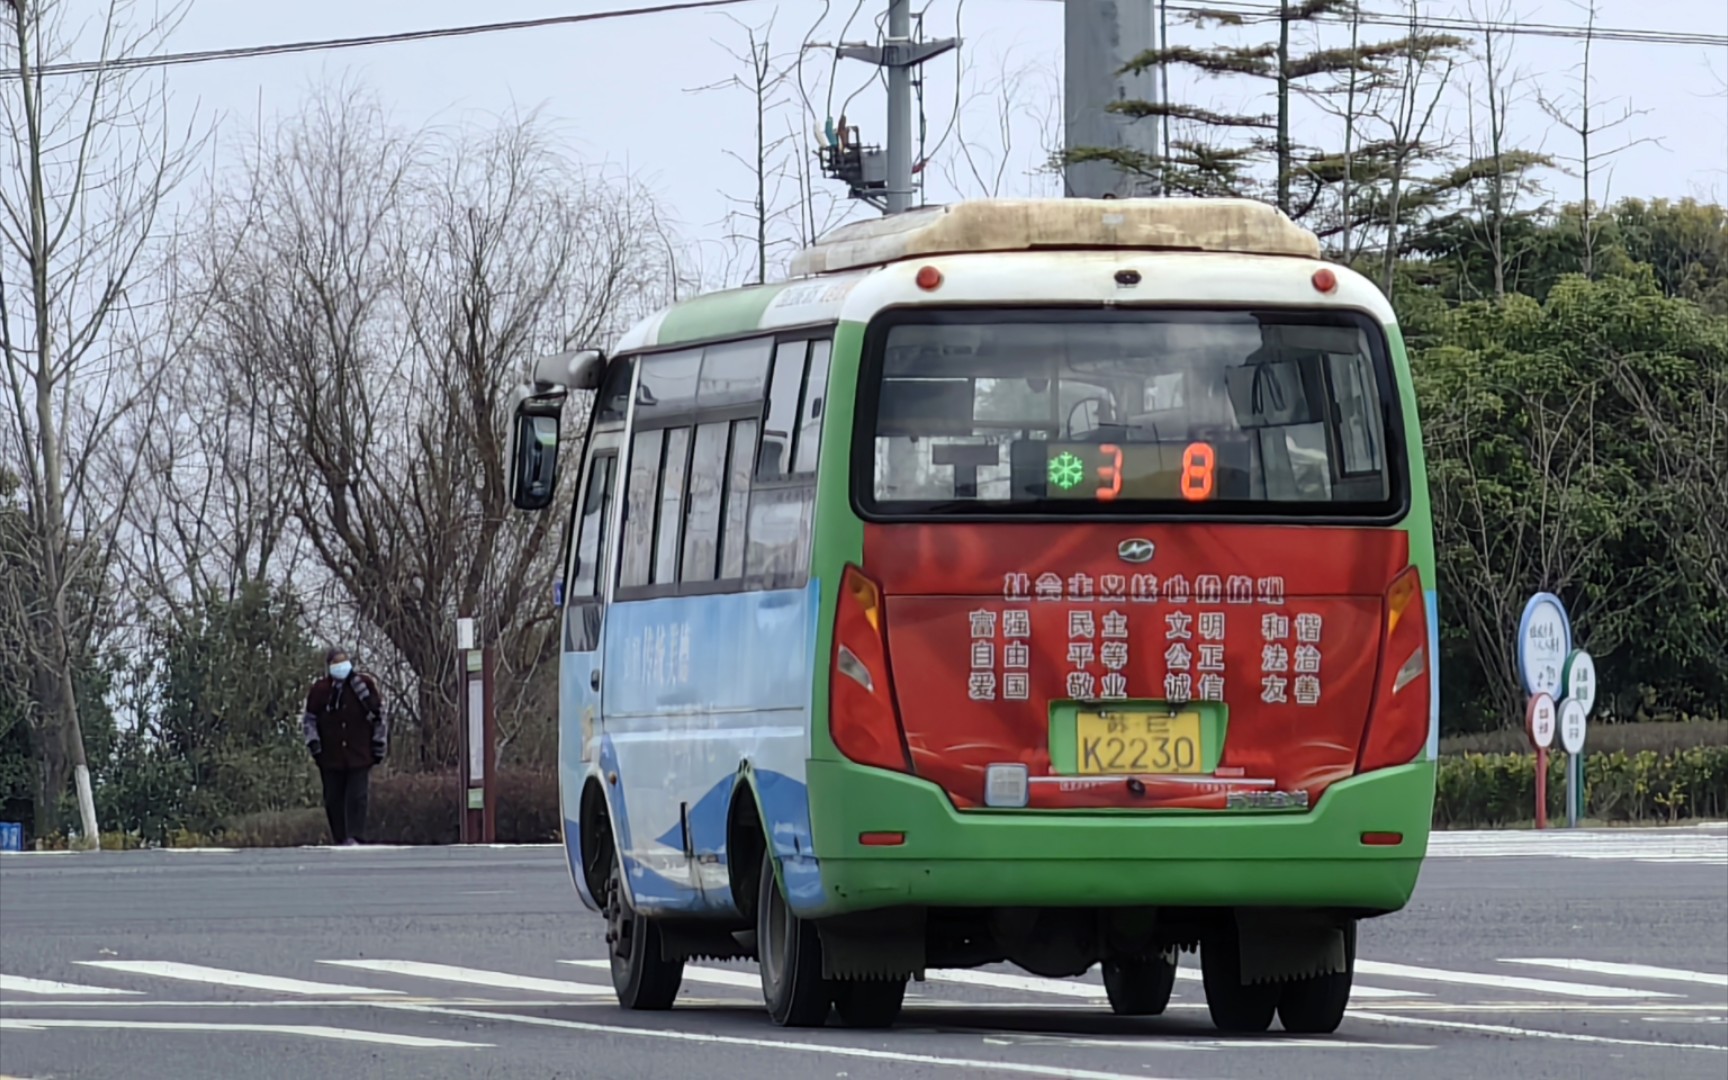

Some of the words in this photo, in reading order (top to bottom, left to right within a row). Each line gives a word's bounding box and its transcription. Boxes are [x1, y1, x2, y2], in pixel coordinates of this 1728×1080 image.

[969, 609, 1031, 638] 富强
[1068, 610, 1128, 638] 民主
[1165, 610, 1225, 639] 文明
[1262, 613, 1322, 643] 和谐
[970, 641, 1030, 669] 自由
[1067, 641, 1128, 670] 平等
[1164, 643, 1225, 671] 公正
[1262, 643, 1322, 673] 法治
[968, 672, 1030, 701] 爱国
[1066, 671, 1128, 700] 敬业
[1164, 672, 1225, 702] 诚信
[1262, 674, 1321, 705] 友善
[1083, 735, 1195, 770] K2230
